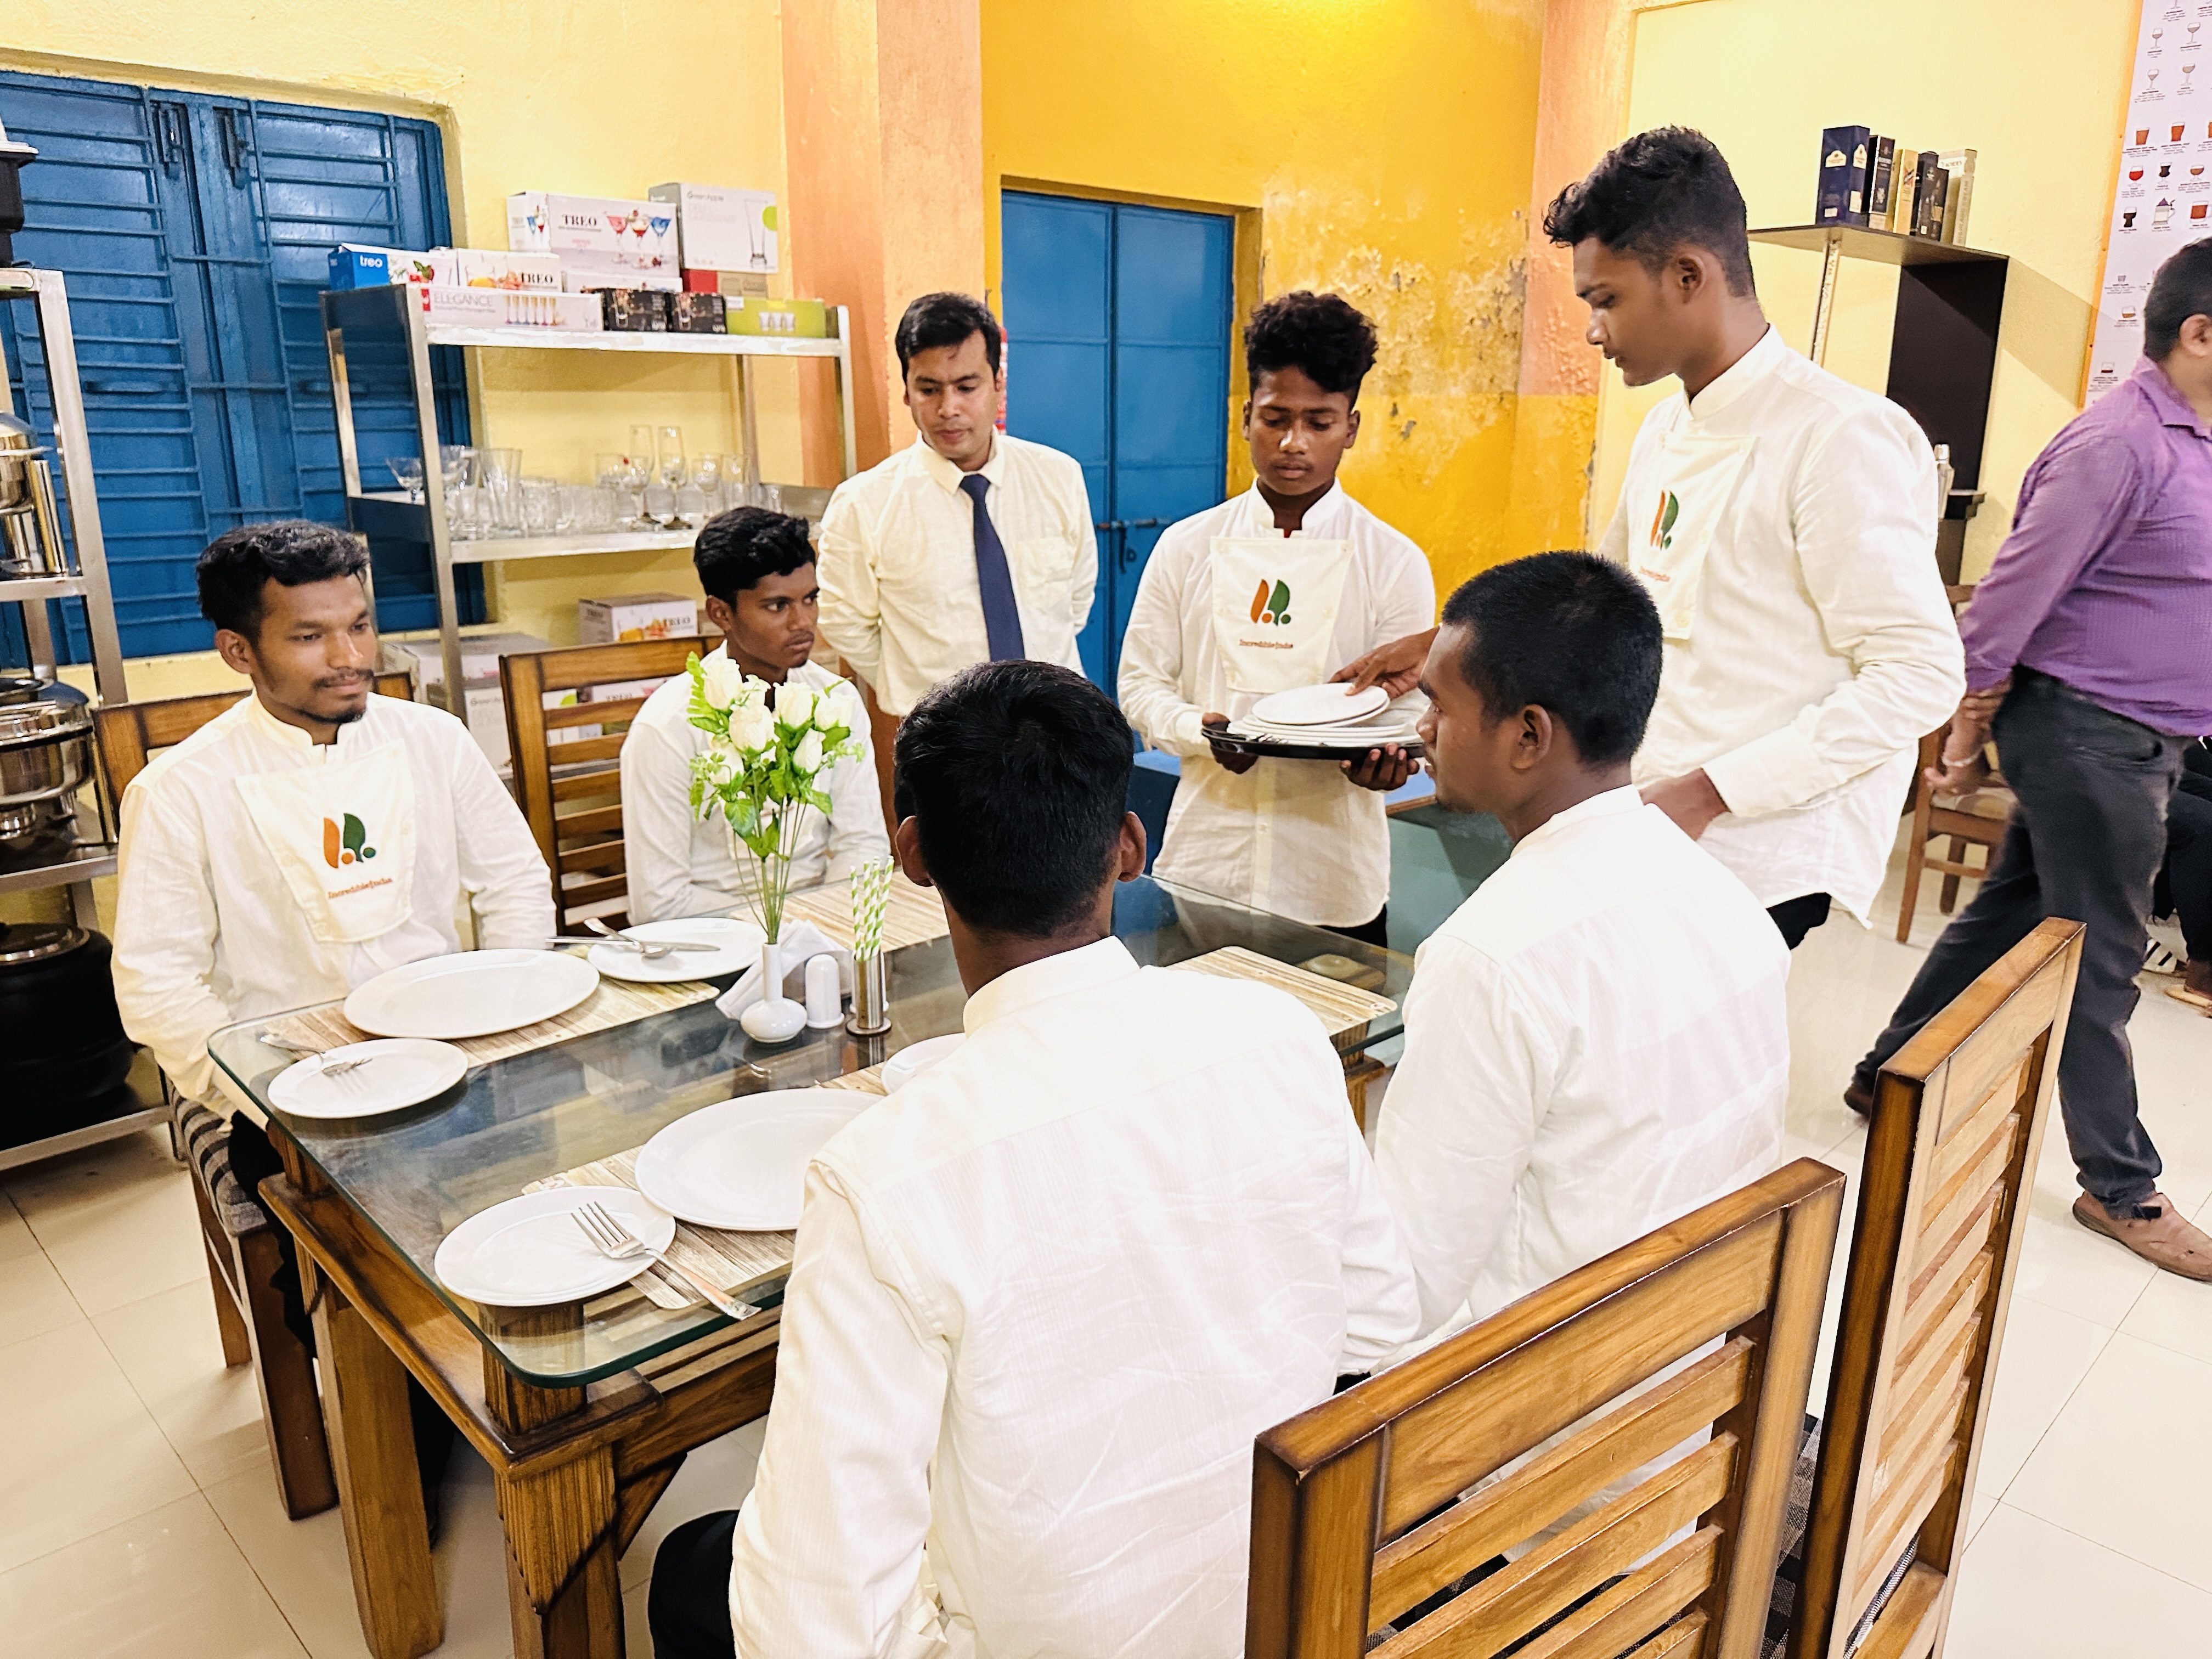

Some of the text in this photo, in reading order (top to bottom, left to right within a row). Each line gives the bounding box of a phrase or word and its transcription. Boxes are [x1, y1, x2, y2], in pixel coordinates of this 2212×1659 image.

[562, 213, 597, 227] TREO
[359, 255, 383, 268] treo
[520, 272, 554, 284] TREO
[434, 292, 493, 307] ELEGANCE
